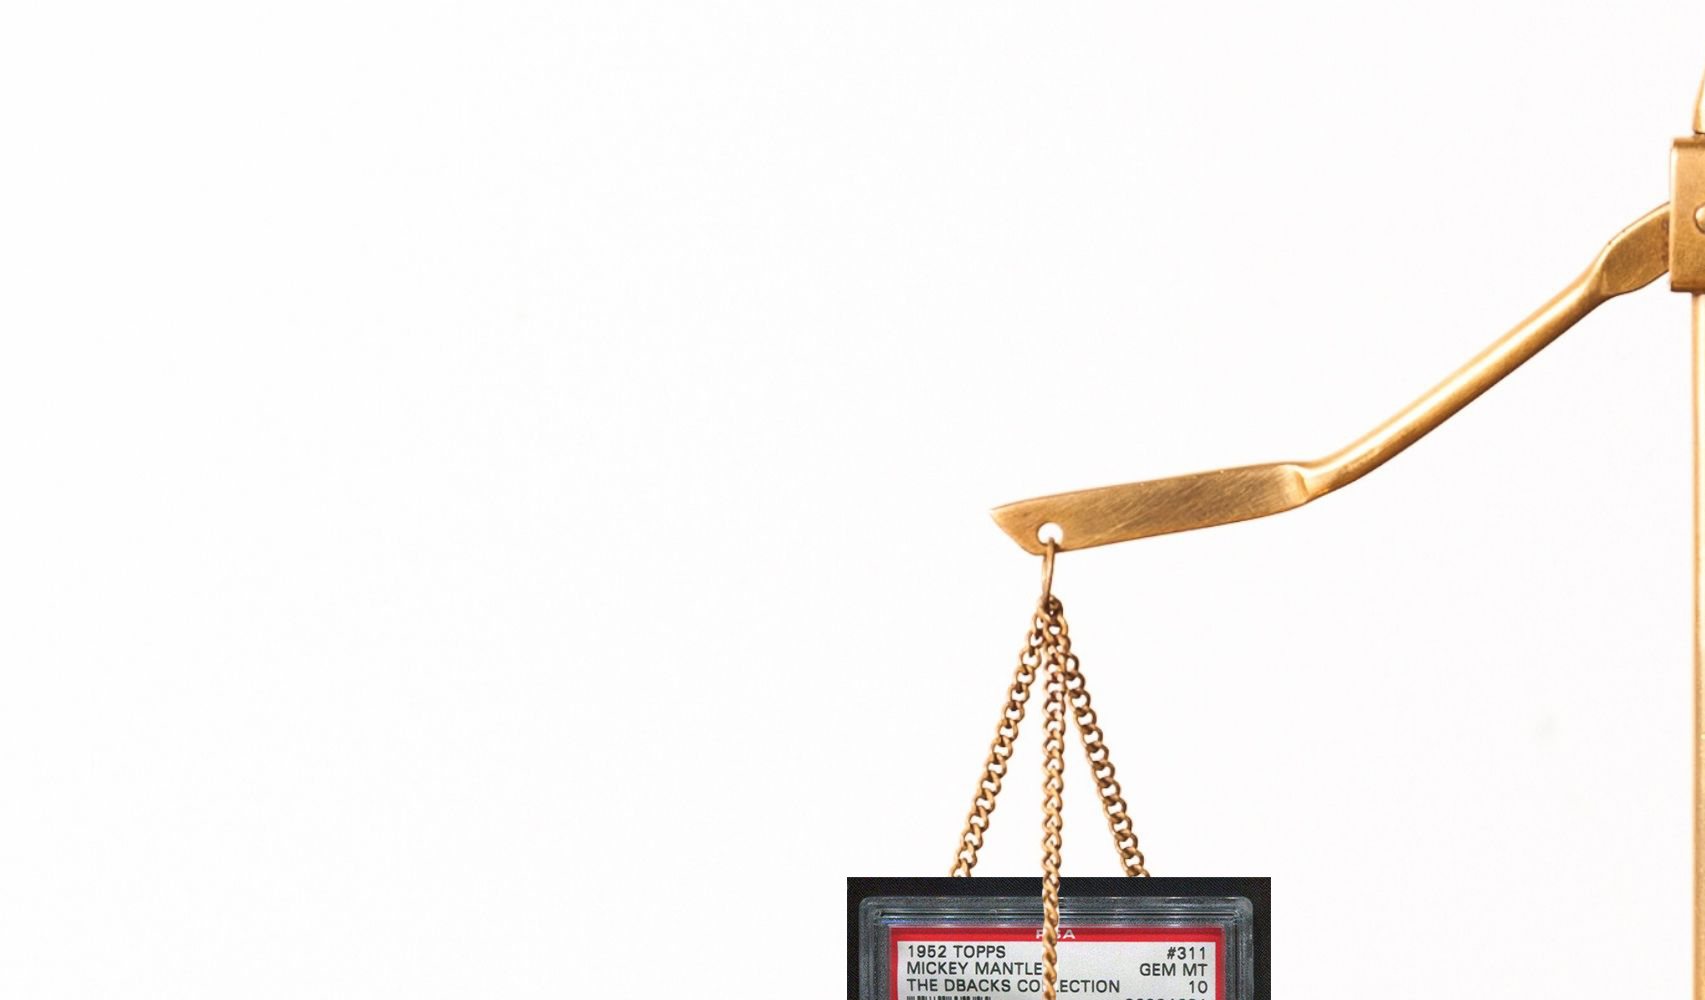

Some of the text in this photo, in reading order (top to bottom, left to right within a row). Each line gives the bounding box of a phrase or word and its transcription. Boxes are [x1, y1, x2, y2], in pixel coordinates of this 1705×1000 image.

[907, 945, 1006, 958] 1952 TOPPS
[1166, 946, 1206, 960] #311
[906, 962, 1043, 976] MICKEY MANTLE
[1139, 963, 1208, 977] GEM MT
[906, 979, 1120, 993] THE DBACKS COECTION
[1189, 981, 1208, 994] 10
